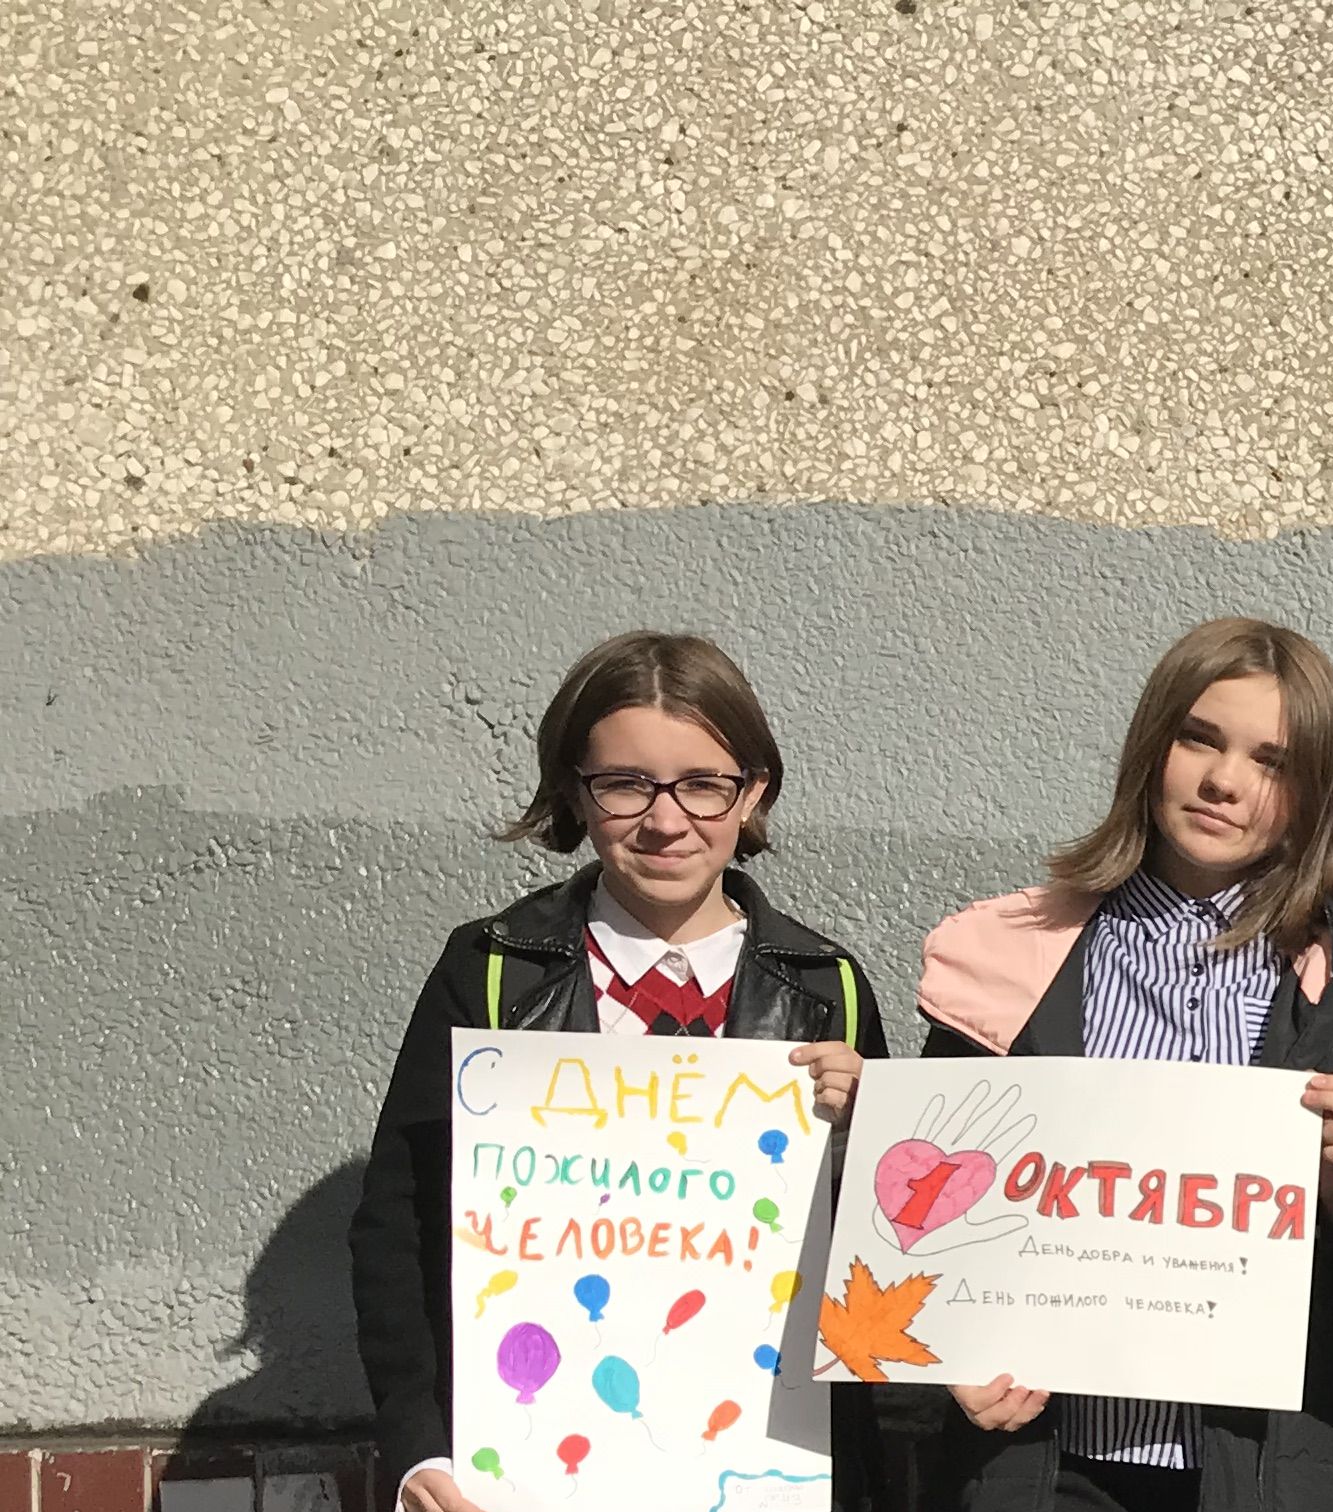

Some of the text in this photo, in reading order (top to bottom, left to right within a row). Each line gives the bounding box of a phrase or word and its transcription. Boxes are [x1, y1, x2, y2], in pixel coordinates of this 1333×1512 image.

[457, 1047, 812, 1136] С ДНЁМ
[472, 1143, 736, 1201] ПОЖИЛОГО
[891, 1151, 1306, 1240] 1 ОКТЯБРЯ
[464, 1210, 760, 1272] ЧЕЛОВЕКА!
